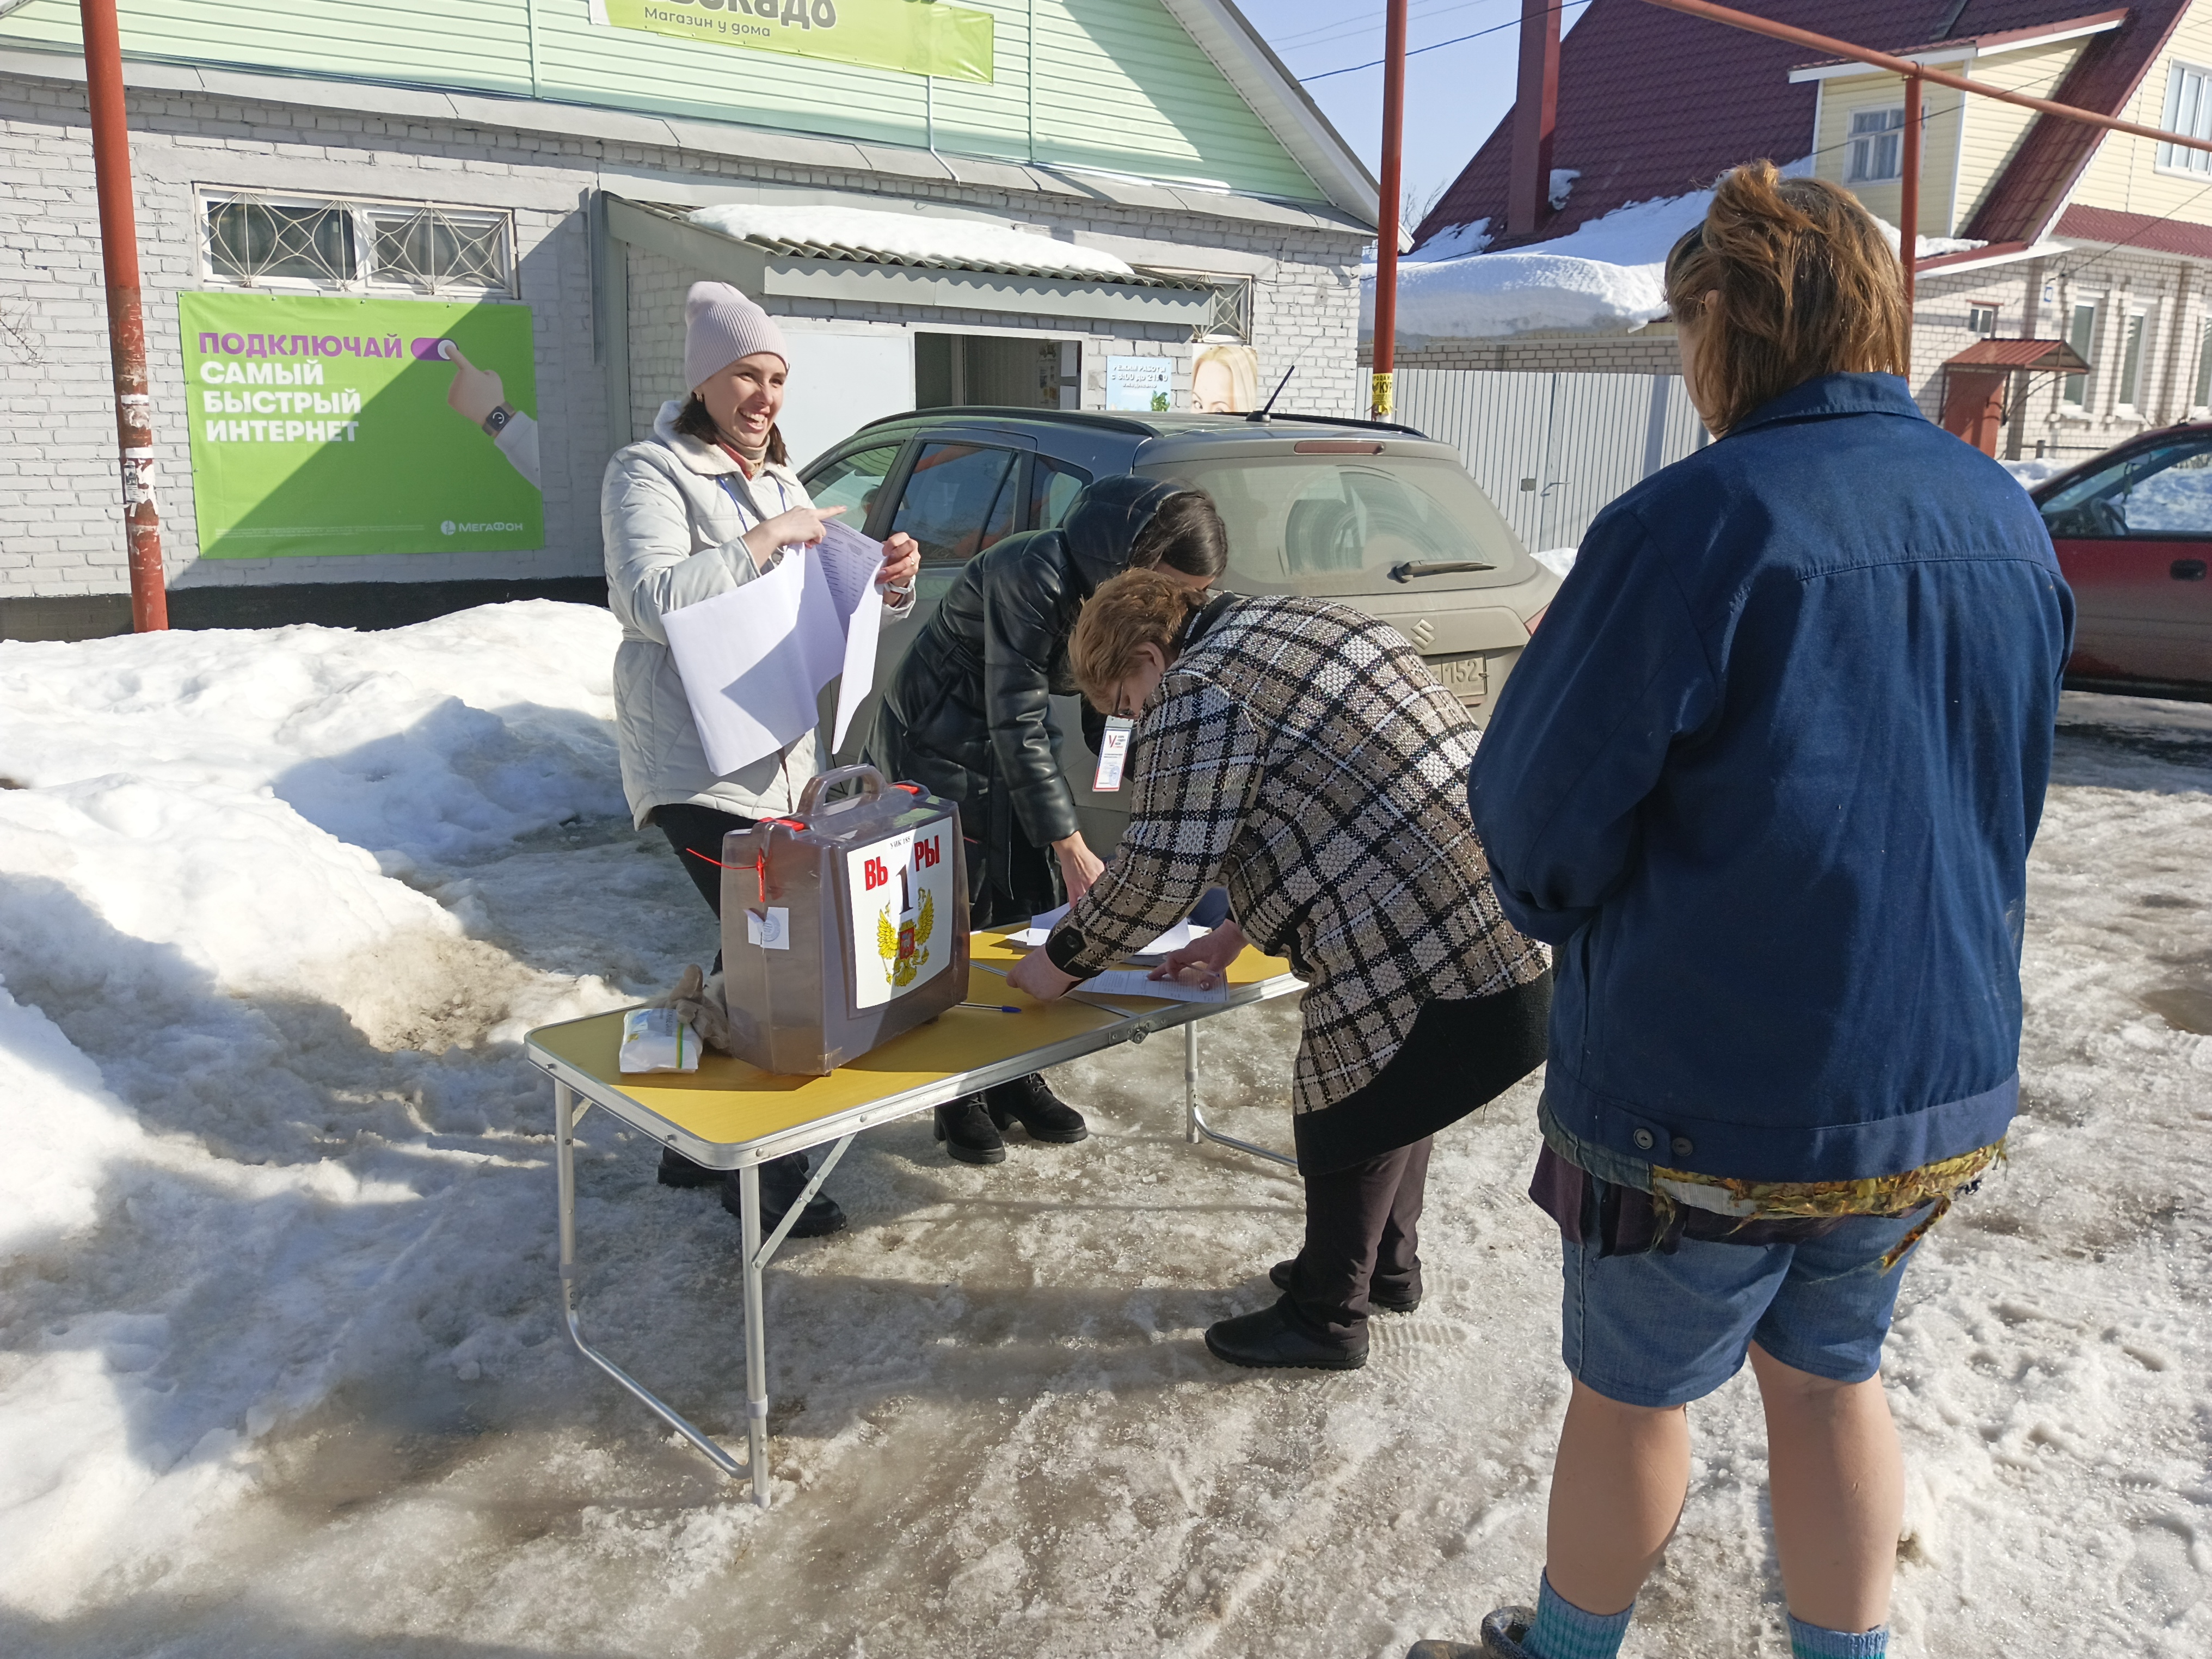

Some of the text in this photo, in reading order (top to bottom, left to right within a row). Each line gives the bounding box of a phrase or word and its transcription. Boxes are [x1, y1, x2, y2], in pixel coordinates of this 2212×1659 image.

[645, 7, 770, 36] Магазин у дома
[199, 333, 402, 358] ПОДКЛЮЧАЙ
[200, 359, 324, 385] САМЫЙ
[203, 388, 361, 414] БЫСТРЫЙ
[206, 420, 359, 441] ИНТЕРНЕТ
[1445, 659, 1478, 683] 152
[895, 864, 914, 915] 1
